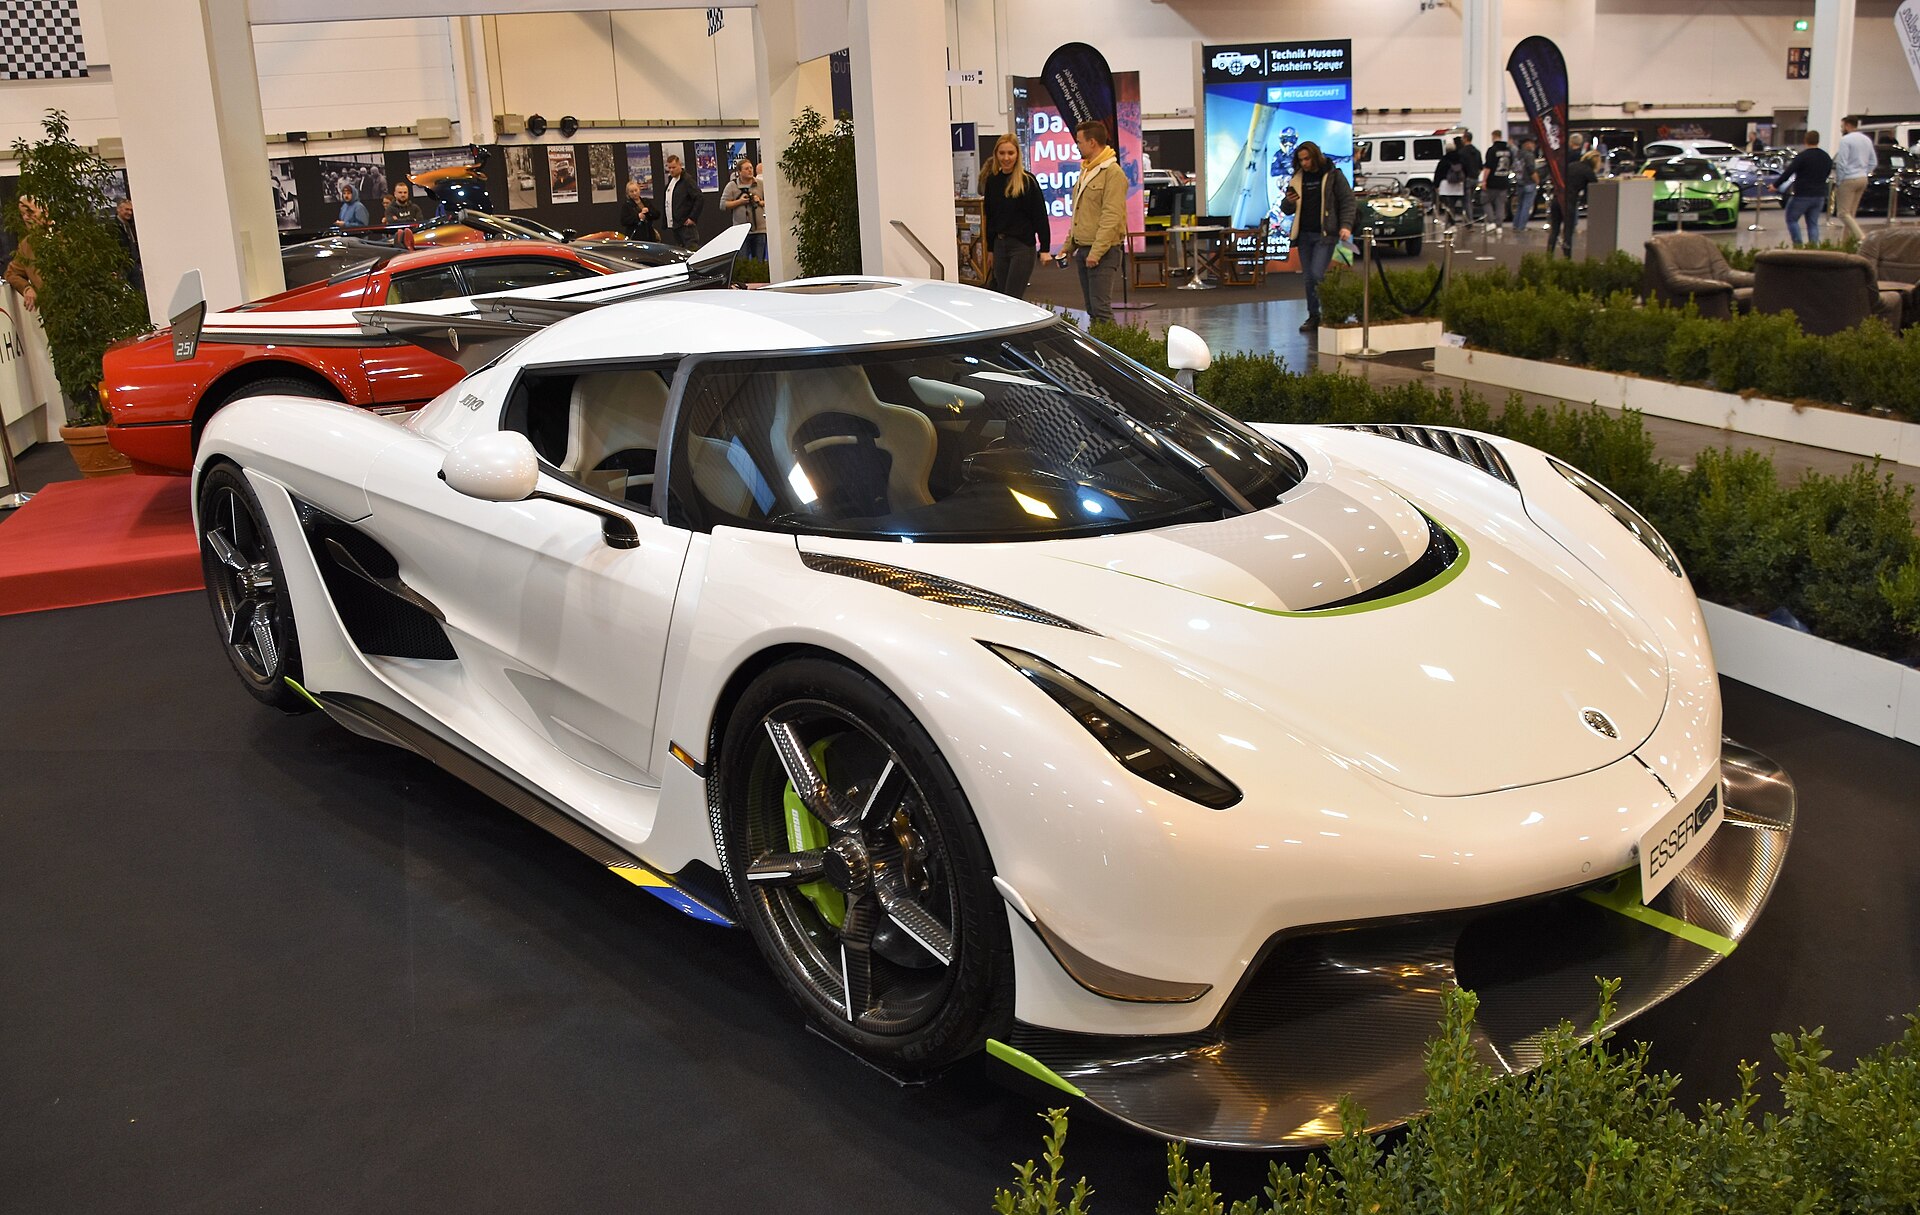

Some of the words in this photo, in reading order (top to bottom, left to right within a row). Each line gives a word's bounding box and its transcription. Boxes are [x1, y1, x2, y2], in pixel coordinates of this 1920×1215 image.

[1271, 49, 1306, 60] Technik
[1307, 48, 1344, 59] Museen
[1271, 61, 1312, 72] Sinsheim
[1312, 61, 1344, 72] Speyer
[1055, 73, 1072, 100] Museen
[1062, 68, 1079, 92] Speyer
[1283, 88, 1340, 99] MITGLIEDSCHAFT
[1075, 91, 1093, 122] Sinsheim
[954, 127, 963, 148] 1
[1034, 140, 1082, 161] Mus
[1236, 237, 1252, 245] Auf
[176, 341, 194, 356] 251
